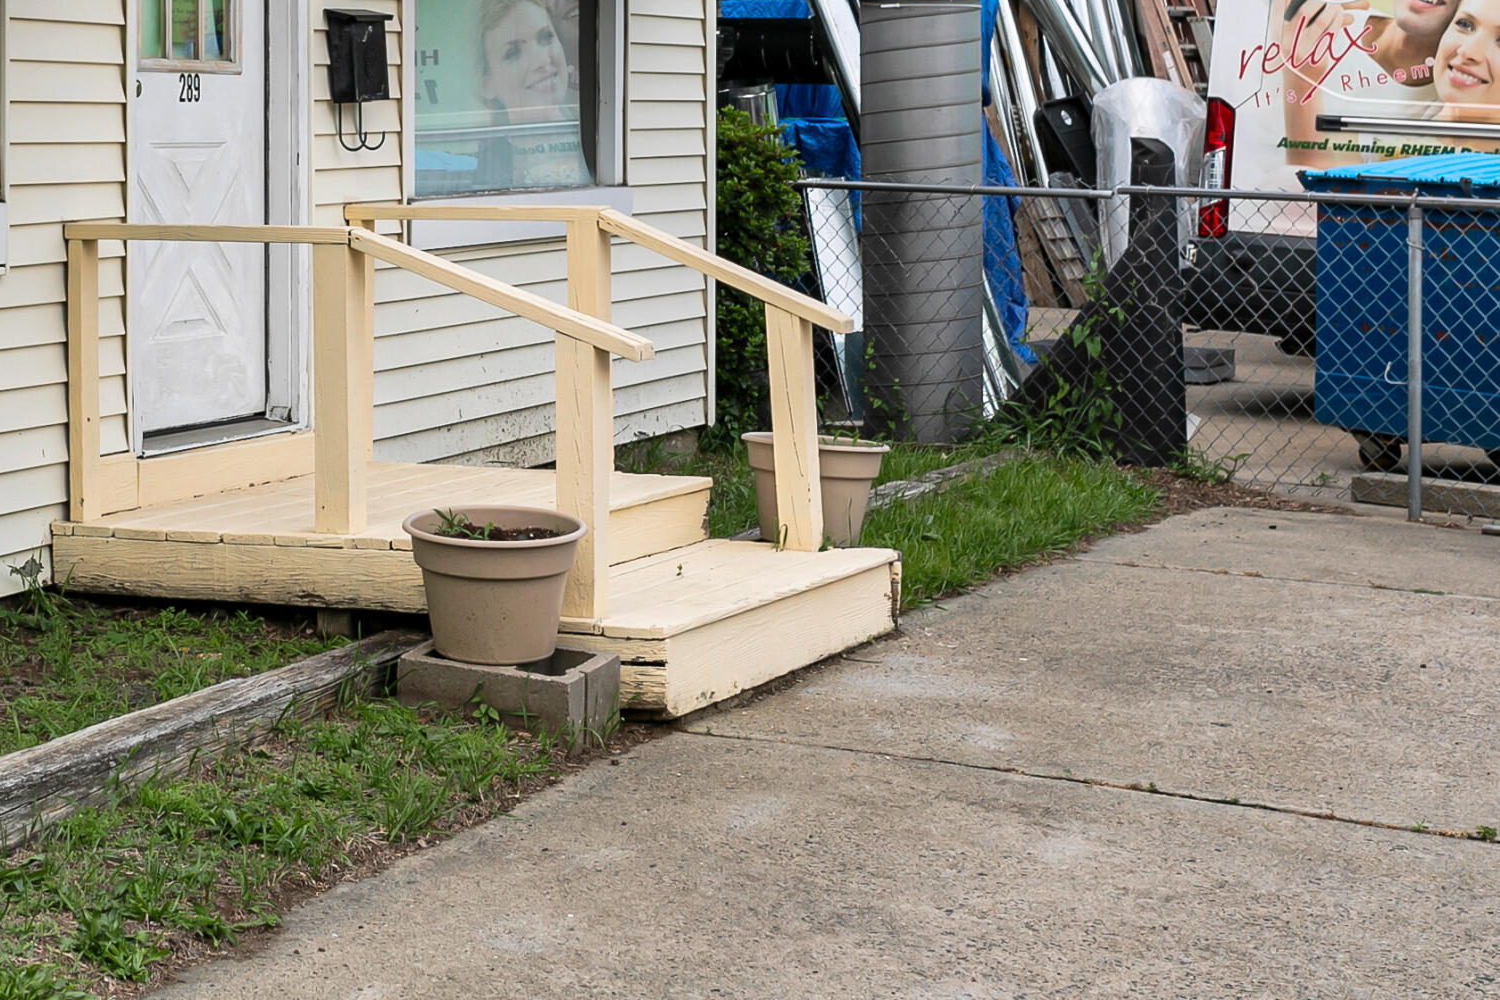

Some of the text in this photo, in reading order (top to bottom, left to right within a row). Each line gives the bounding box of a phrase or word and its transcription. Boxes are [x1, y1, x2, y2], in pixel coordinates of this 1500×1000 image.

[1238, 15, 1377, 104] relax
[179, 73, 201, 102] 289
[1339, 62, 1430, 93] Rheem
[1276, 136, 1329, 151] Award
[1332, 138, 1397, 156] winning
[1399, 143, 1457, 157] RHEEM
